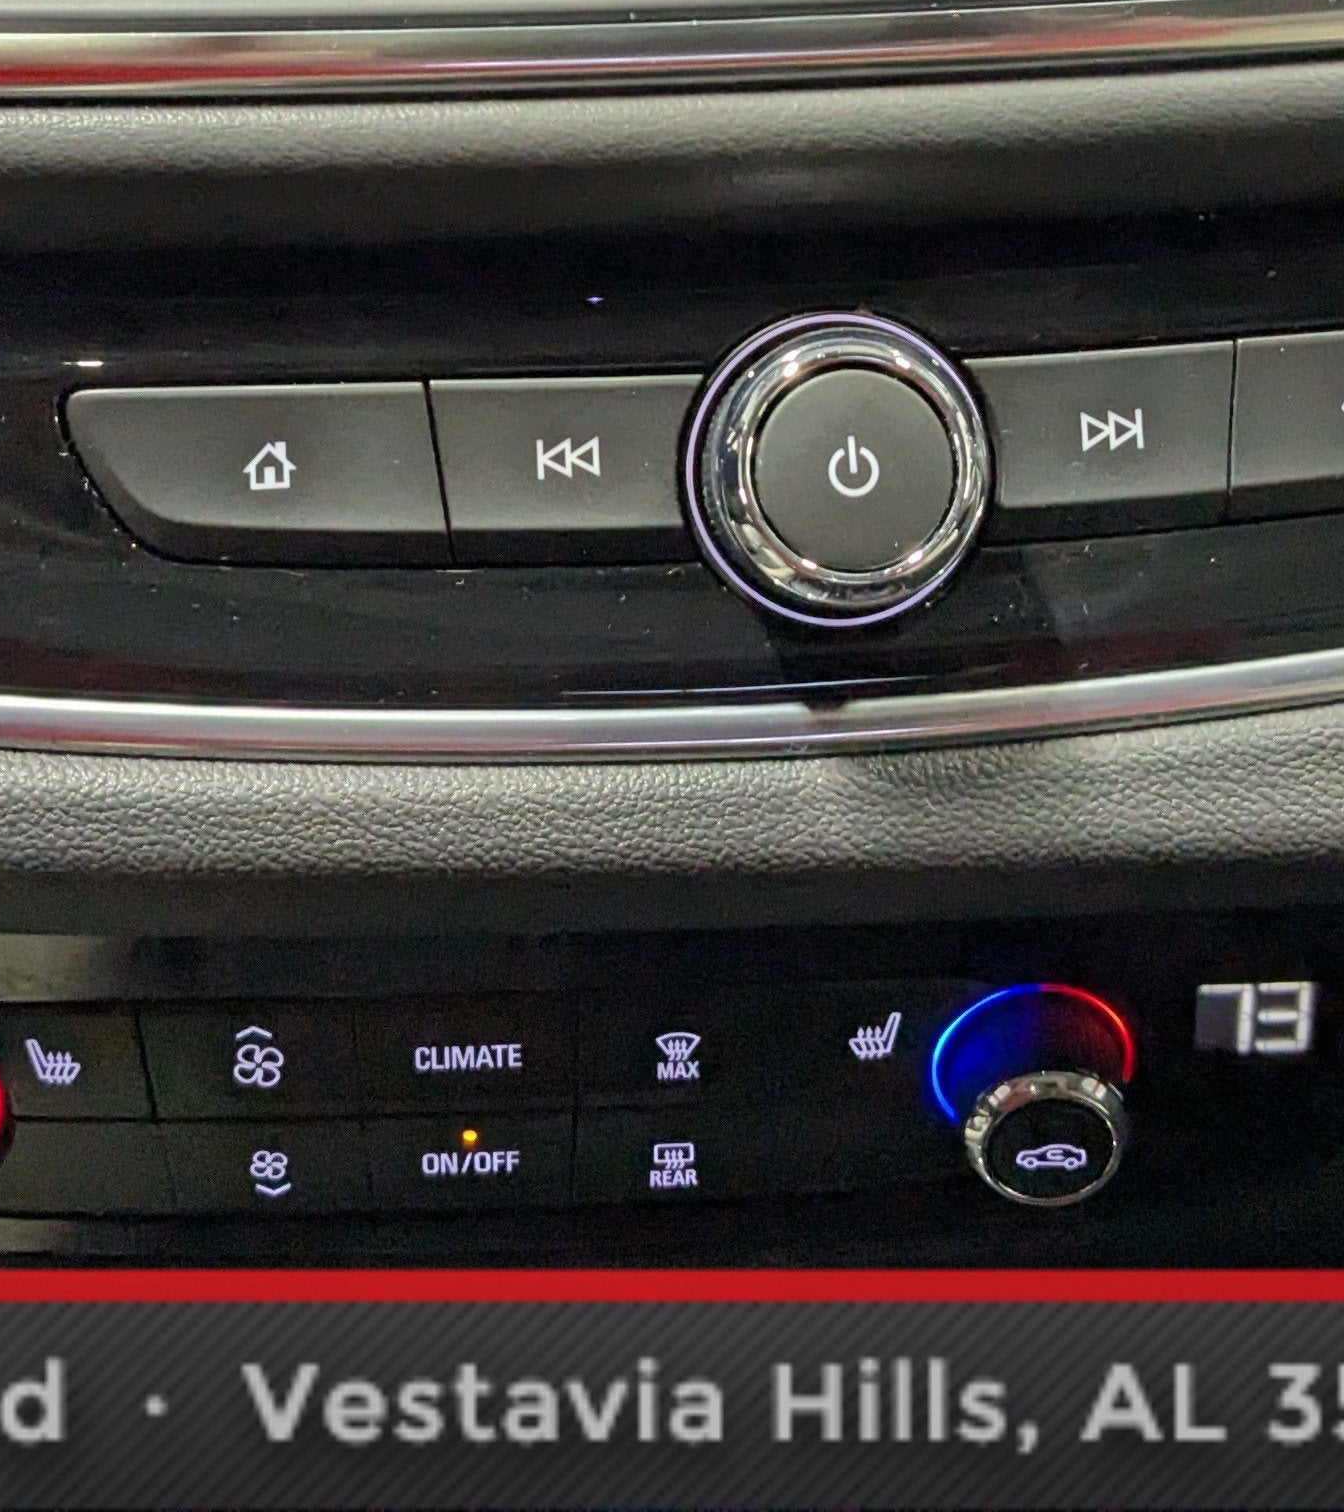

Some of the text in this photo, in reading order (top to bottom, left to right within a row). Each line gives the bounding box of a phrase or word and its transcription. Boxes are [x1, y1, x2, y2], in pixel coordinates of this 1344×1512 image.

[1197, 980, 1315, 1055] 73
[413, 1042, 523, 1073] CLIMATE
[656, 1060, 700, 1082] MAX
[420, 1149, 521, 1176] ON/OFF
[648, 1167, 699, 1189] REAR
